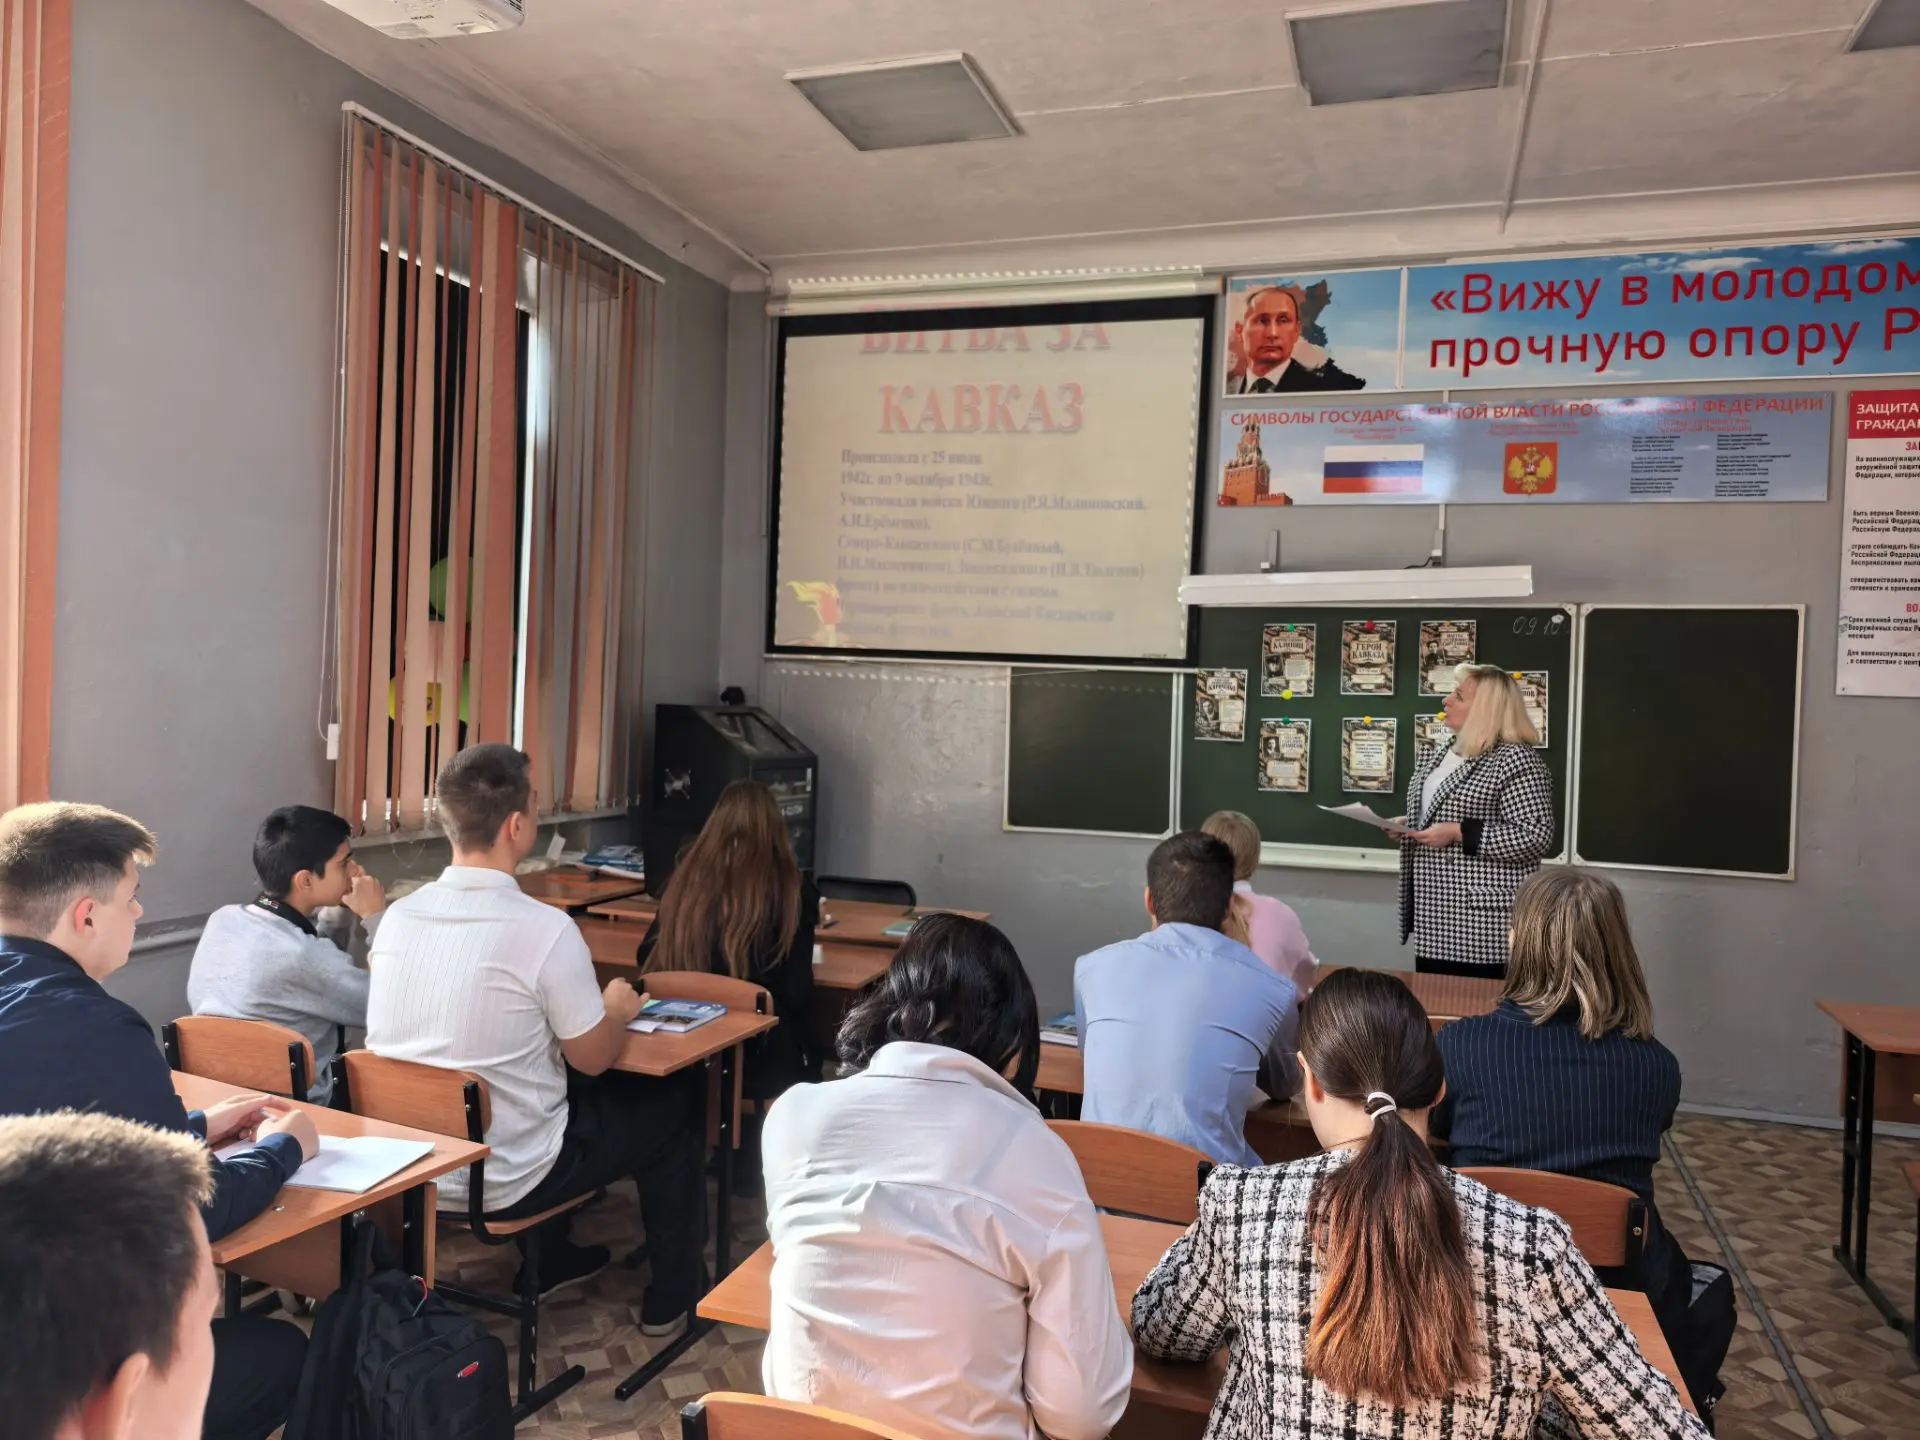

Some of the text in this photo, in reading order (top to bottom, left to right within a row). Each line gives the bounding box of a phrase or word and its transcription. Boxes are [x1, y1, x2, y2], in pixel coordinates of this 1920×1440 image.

[1430, 261, 1920, 320] «Вижу в молодом
[1430, 329, 1666, 377] прочную
[1689, 321, 1861, 366] опору
[878, 382, 1086, 434] КАВКАЗ
[1231, 411, 1315, 426] СИМВОЛЫ
[1493, 404, 1563, 419] ВЛАСТИ
[1703, 396, 1824, 415] ФЕДЕРАЦИИ
[1856, 402, 1919, 416] ЗАЩИТА
[1905, 441, 1920, 451] ЗА
